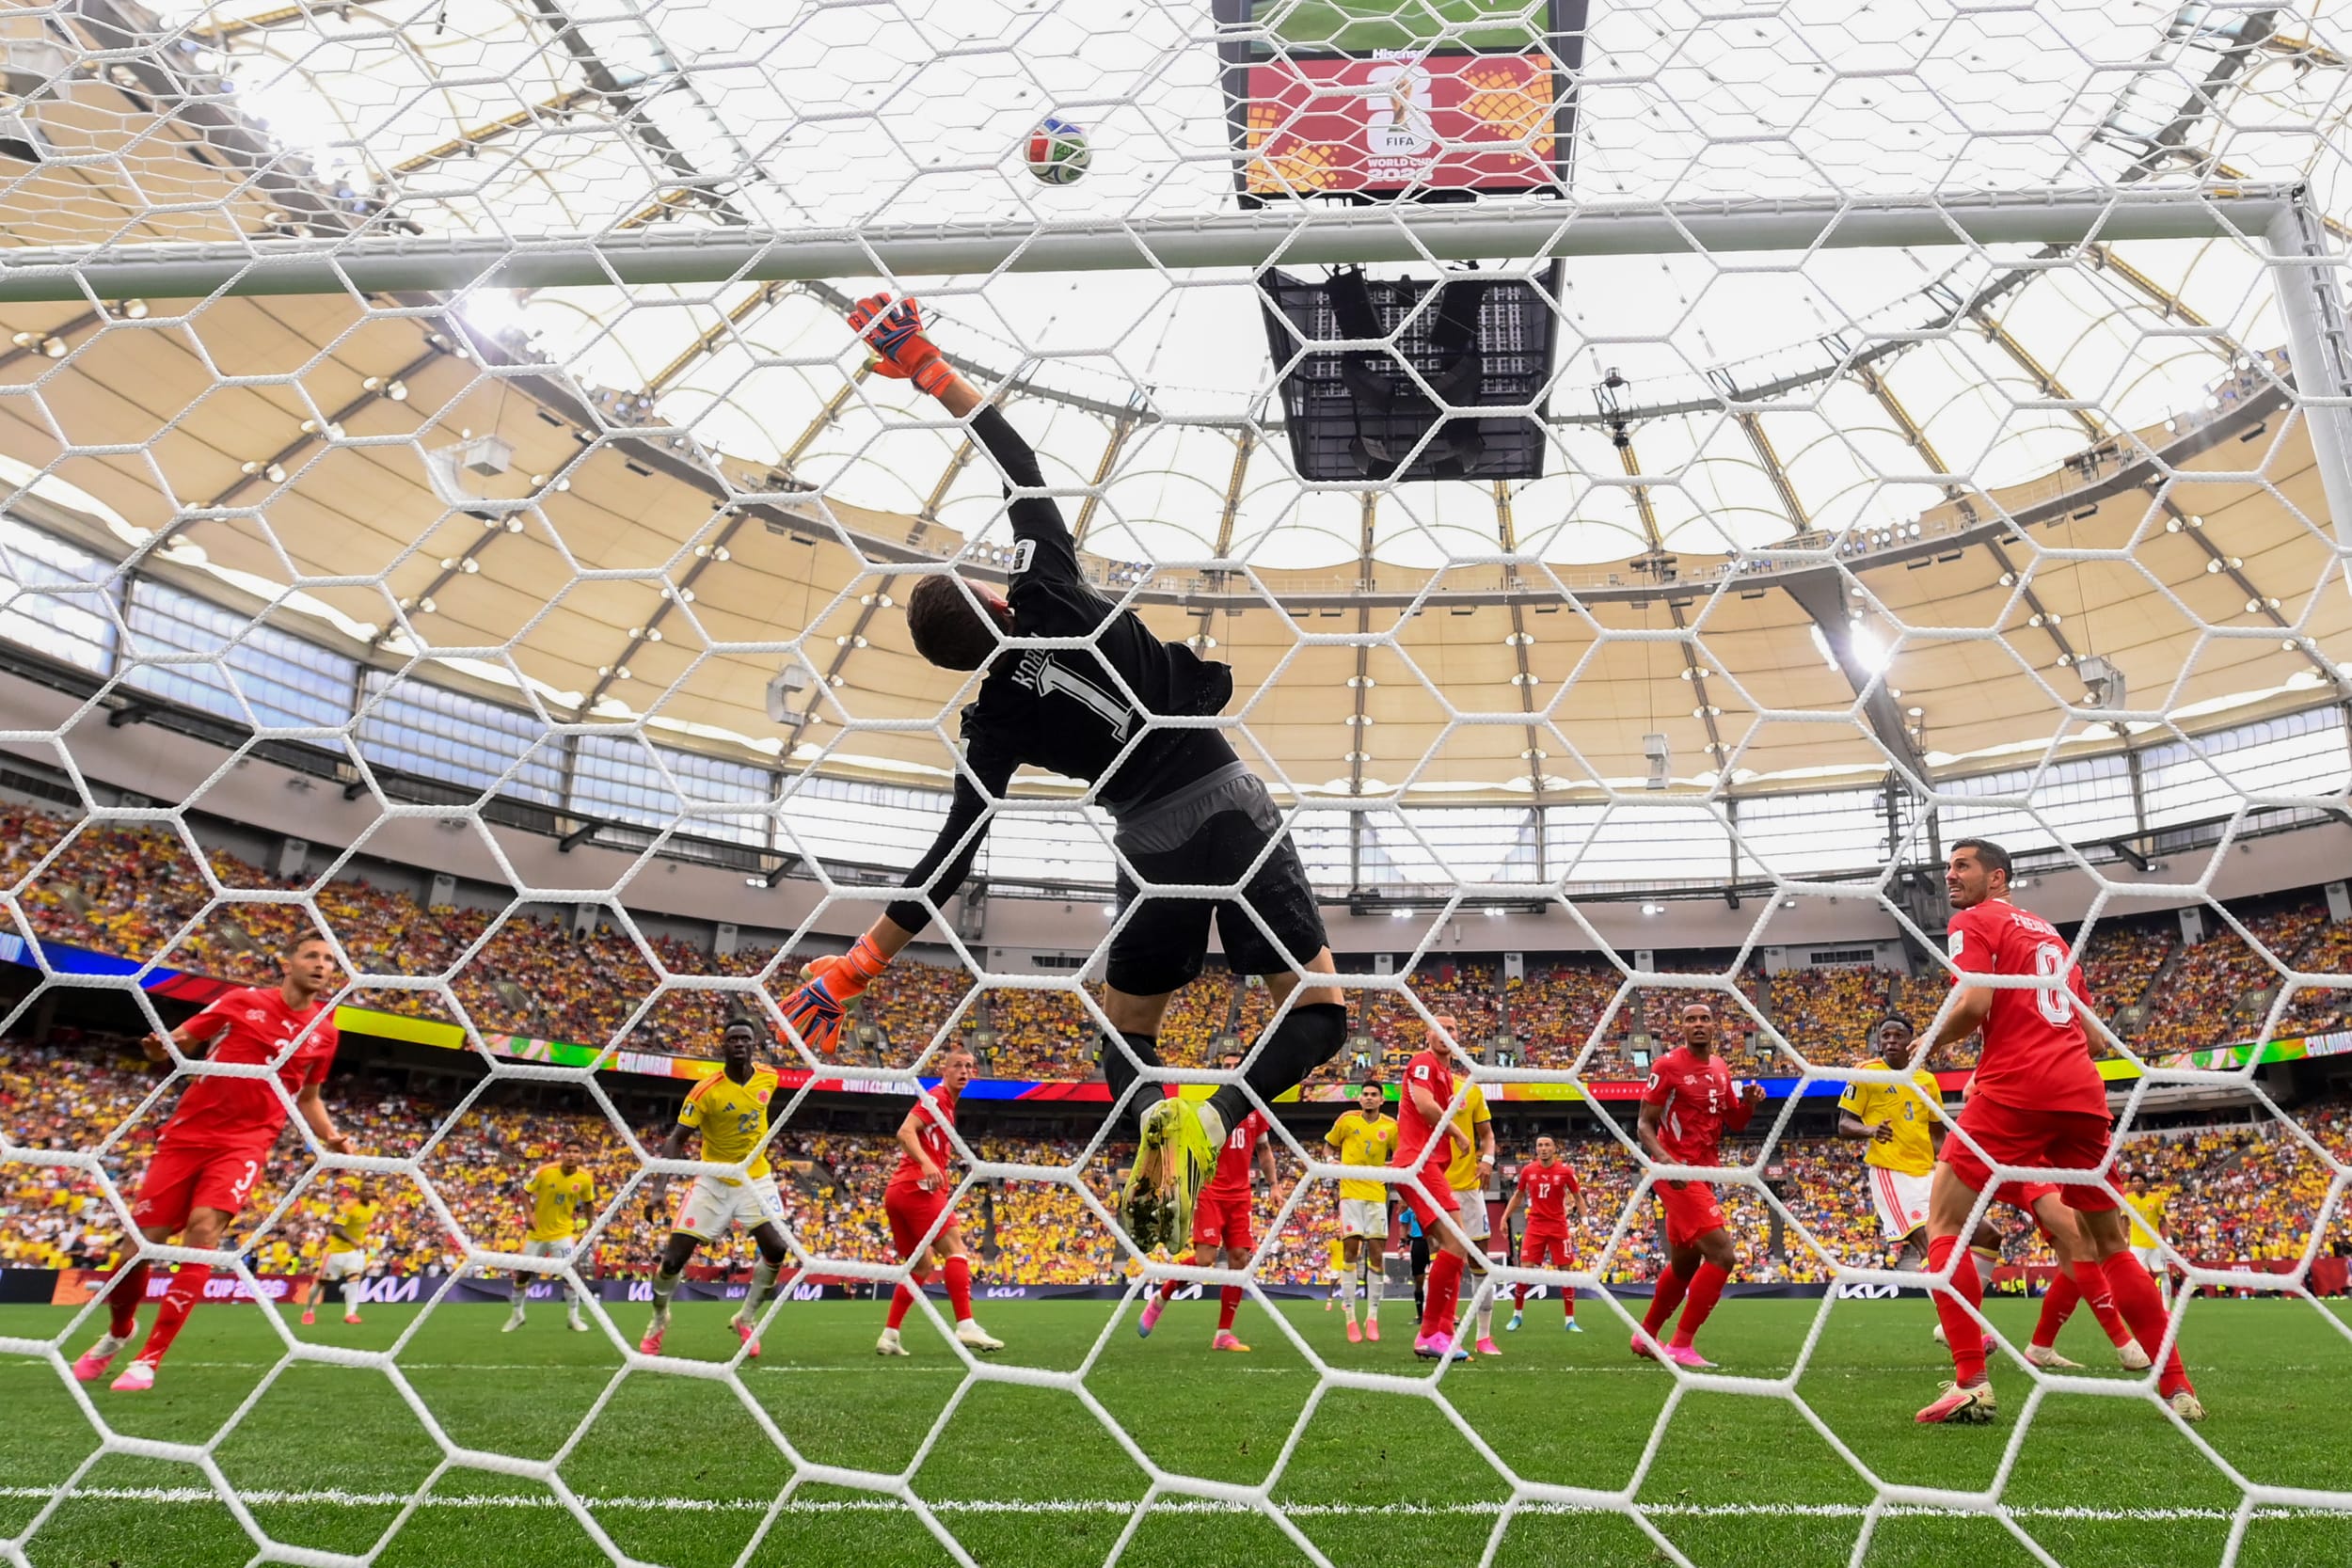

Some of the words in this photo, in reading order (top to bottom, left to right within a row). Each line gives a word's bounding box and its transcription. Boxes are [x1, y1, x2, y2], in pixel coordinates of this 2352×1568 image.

[1372, 48, 1424, 61] Hisens
[1386, 136, 1415, 147] FIFA
[1367, 157, 1409, 168] WORLD
[1409, 157, 1433, 168] CUP
[1010, 631, 1046, 690] KOB
[1036, 652, 1135, 744] 1
[2036, 942, 2074, 1028] 8
[1708, 1088, 1718, 1115] 5
[1903, 1101, 1915, 1121] 3
[738, 1109, 759, 1133] 23
[1230, 1127, 1246, 1149] 10
[1365, 1139, 1373, 1156] 7
[235, 1160, 259, 1191] 3
[1537, 1182, 1551, 1199] 17
[203, 1278, 235, 1298] CUP
